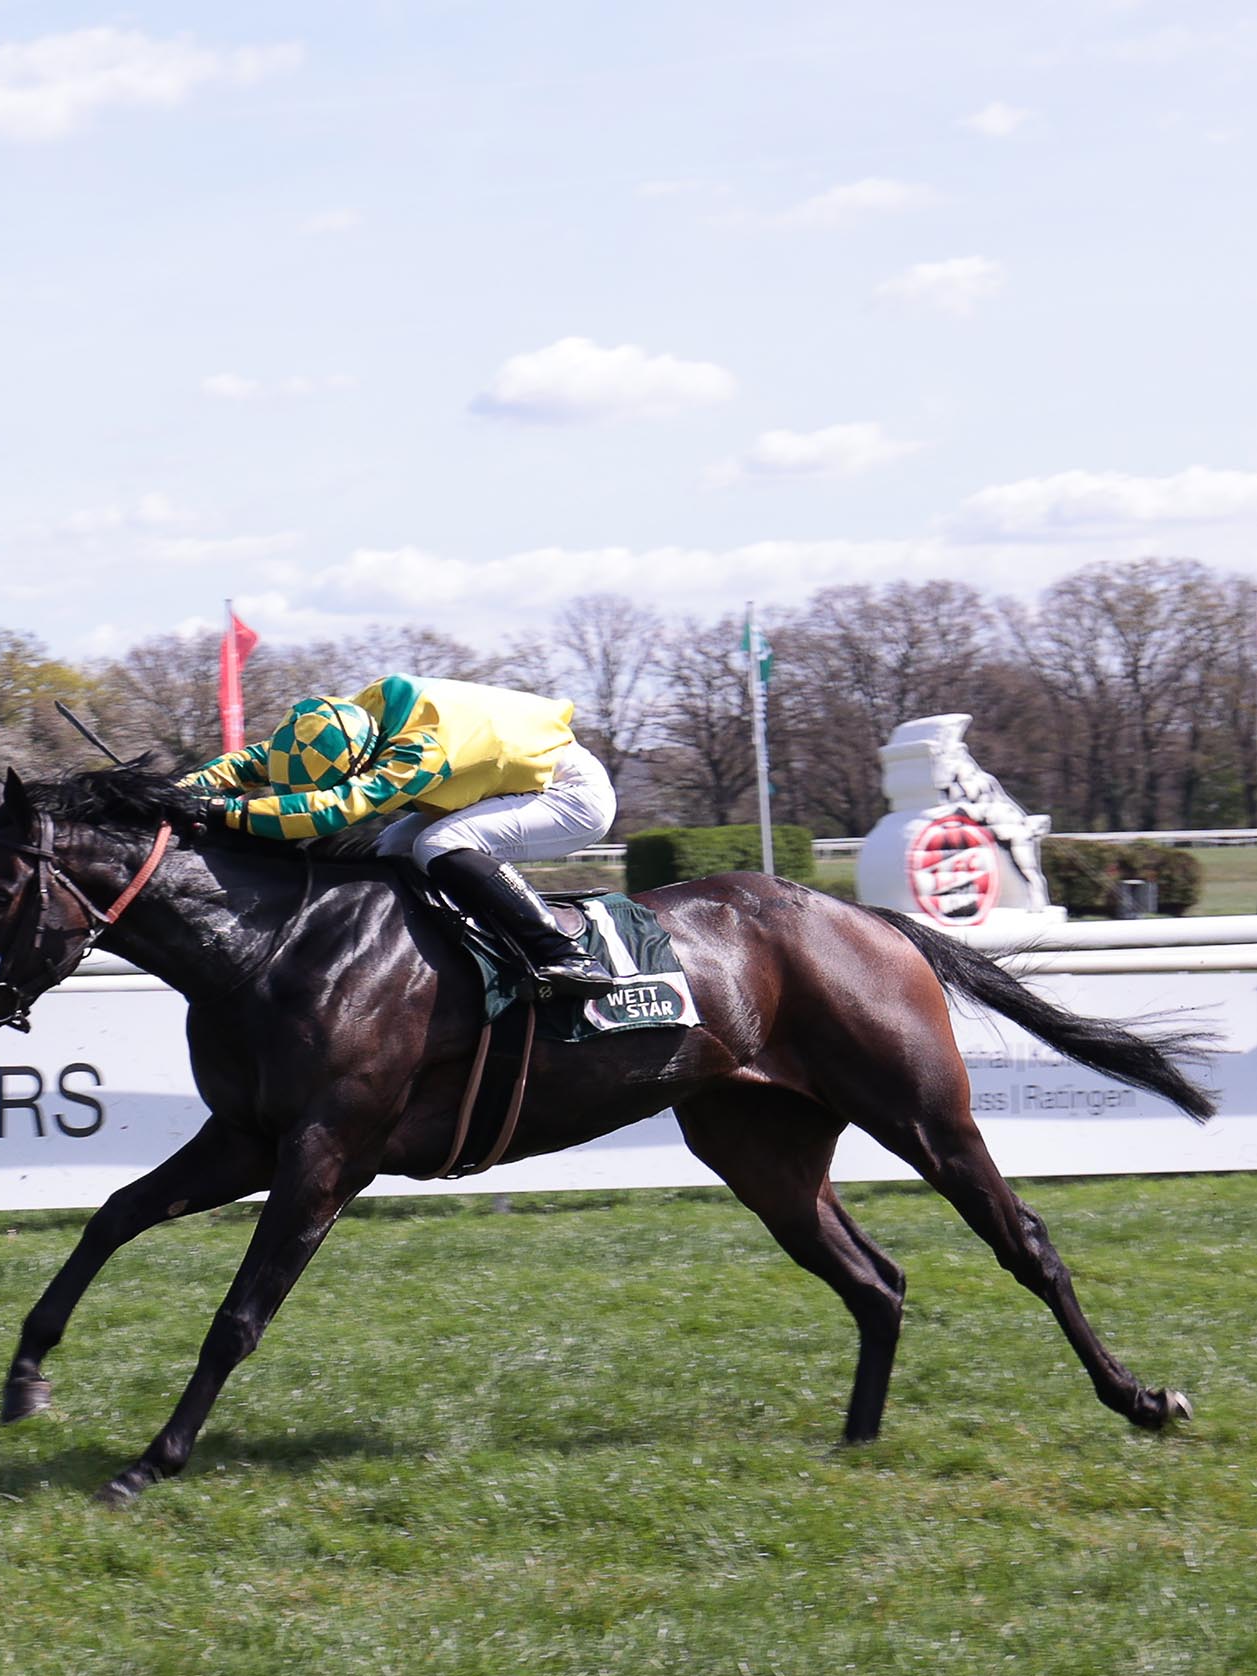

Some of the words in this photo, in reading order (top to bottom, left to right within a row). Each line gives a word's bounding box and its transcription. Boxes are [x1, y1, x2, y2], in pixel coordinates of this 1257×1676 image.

[582, 899, 640, 978] 1
[606, 986, 658, 1007] WETT
[626, 1000, 674, 1018] STAR
